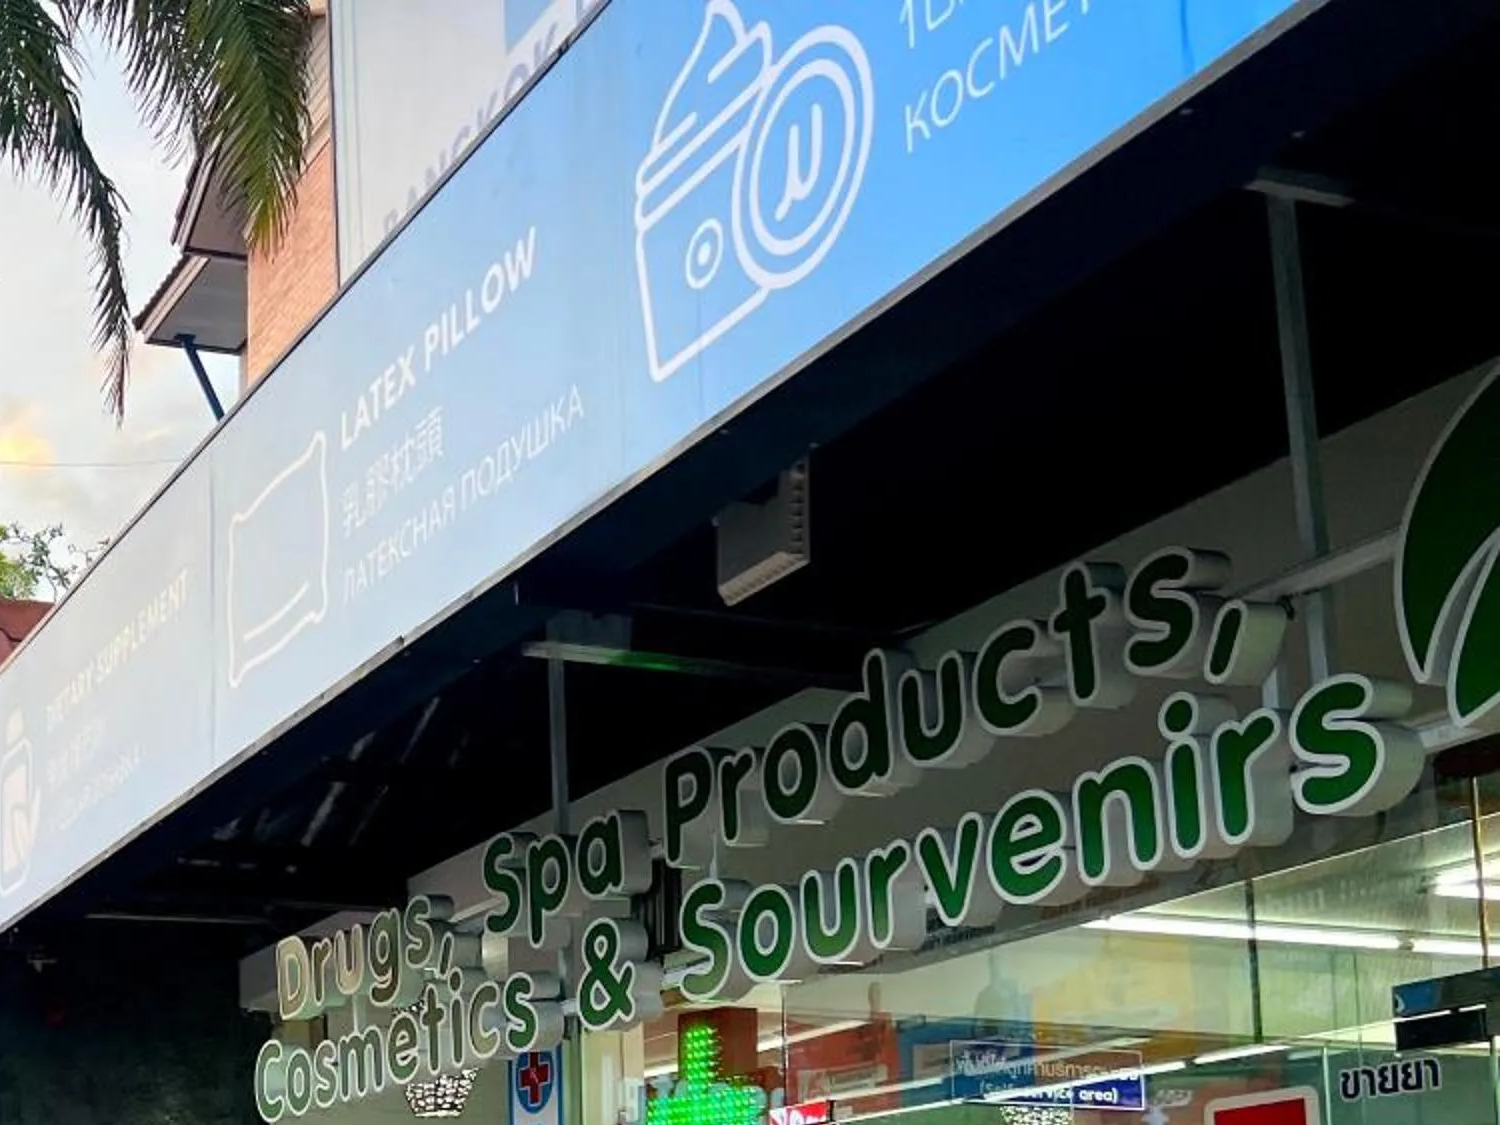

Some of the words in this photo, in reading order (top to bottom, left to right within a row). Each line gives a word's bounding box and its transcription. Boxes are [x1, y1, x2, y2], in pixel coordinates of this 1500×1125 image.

[905, 0, 1090, 154] КОСМЕ
[340, 345, 416, 451] LATEX
[424, 226, 536, 372] PILLOW
[343, 488, 456, 604] ЛАТЕКСНАЯ
[460, 383, 585, 512] ПОДУШКА
[96, 568, 189, 684] SUPPLEMENT
[275, 890, 453, 1023] Drugs,
[483, 807, 624, 949] Spa
[661, 545, 1249, 870] Products,
[253, 970, 540, 1124] Cosmetics
[578, 916, 636, 1031] &
[678, 671, 1388, 1004] Sourvenirs
[1079, 1088, 1118, 1103] area)
[1340, 1057, 1441, 1101] ขายยา
